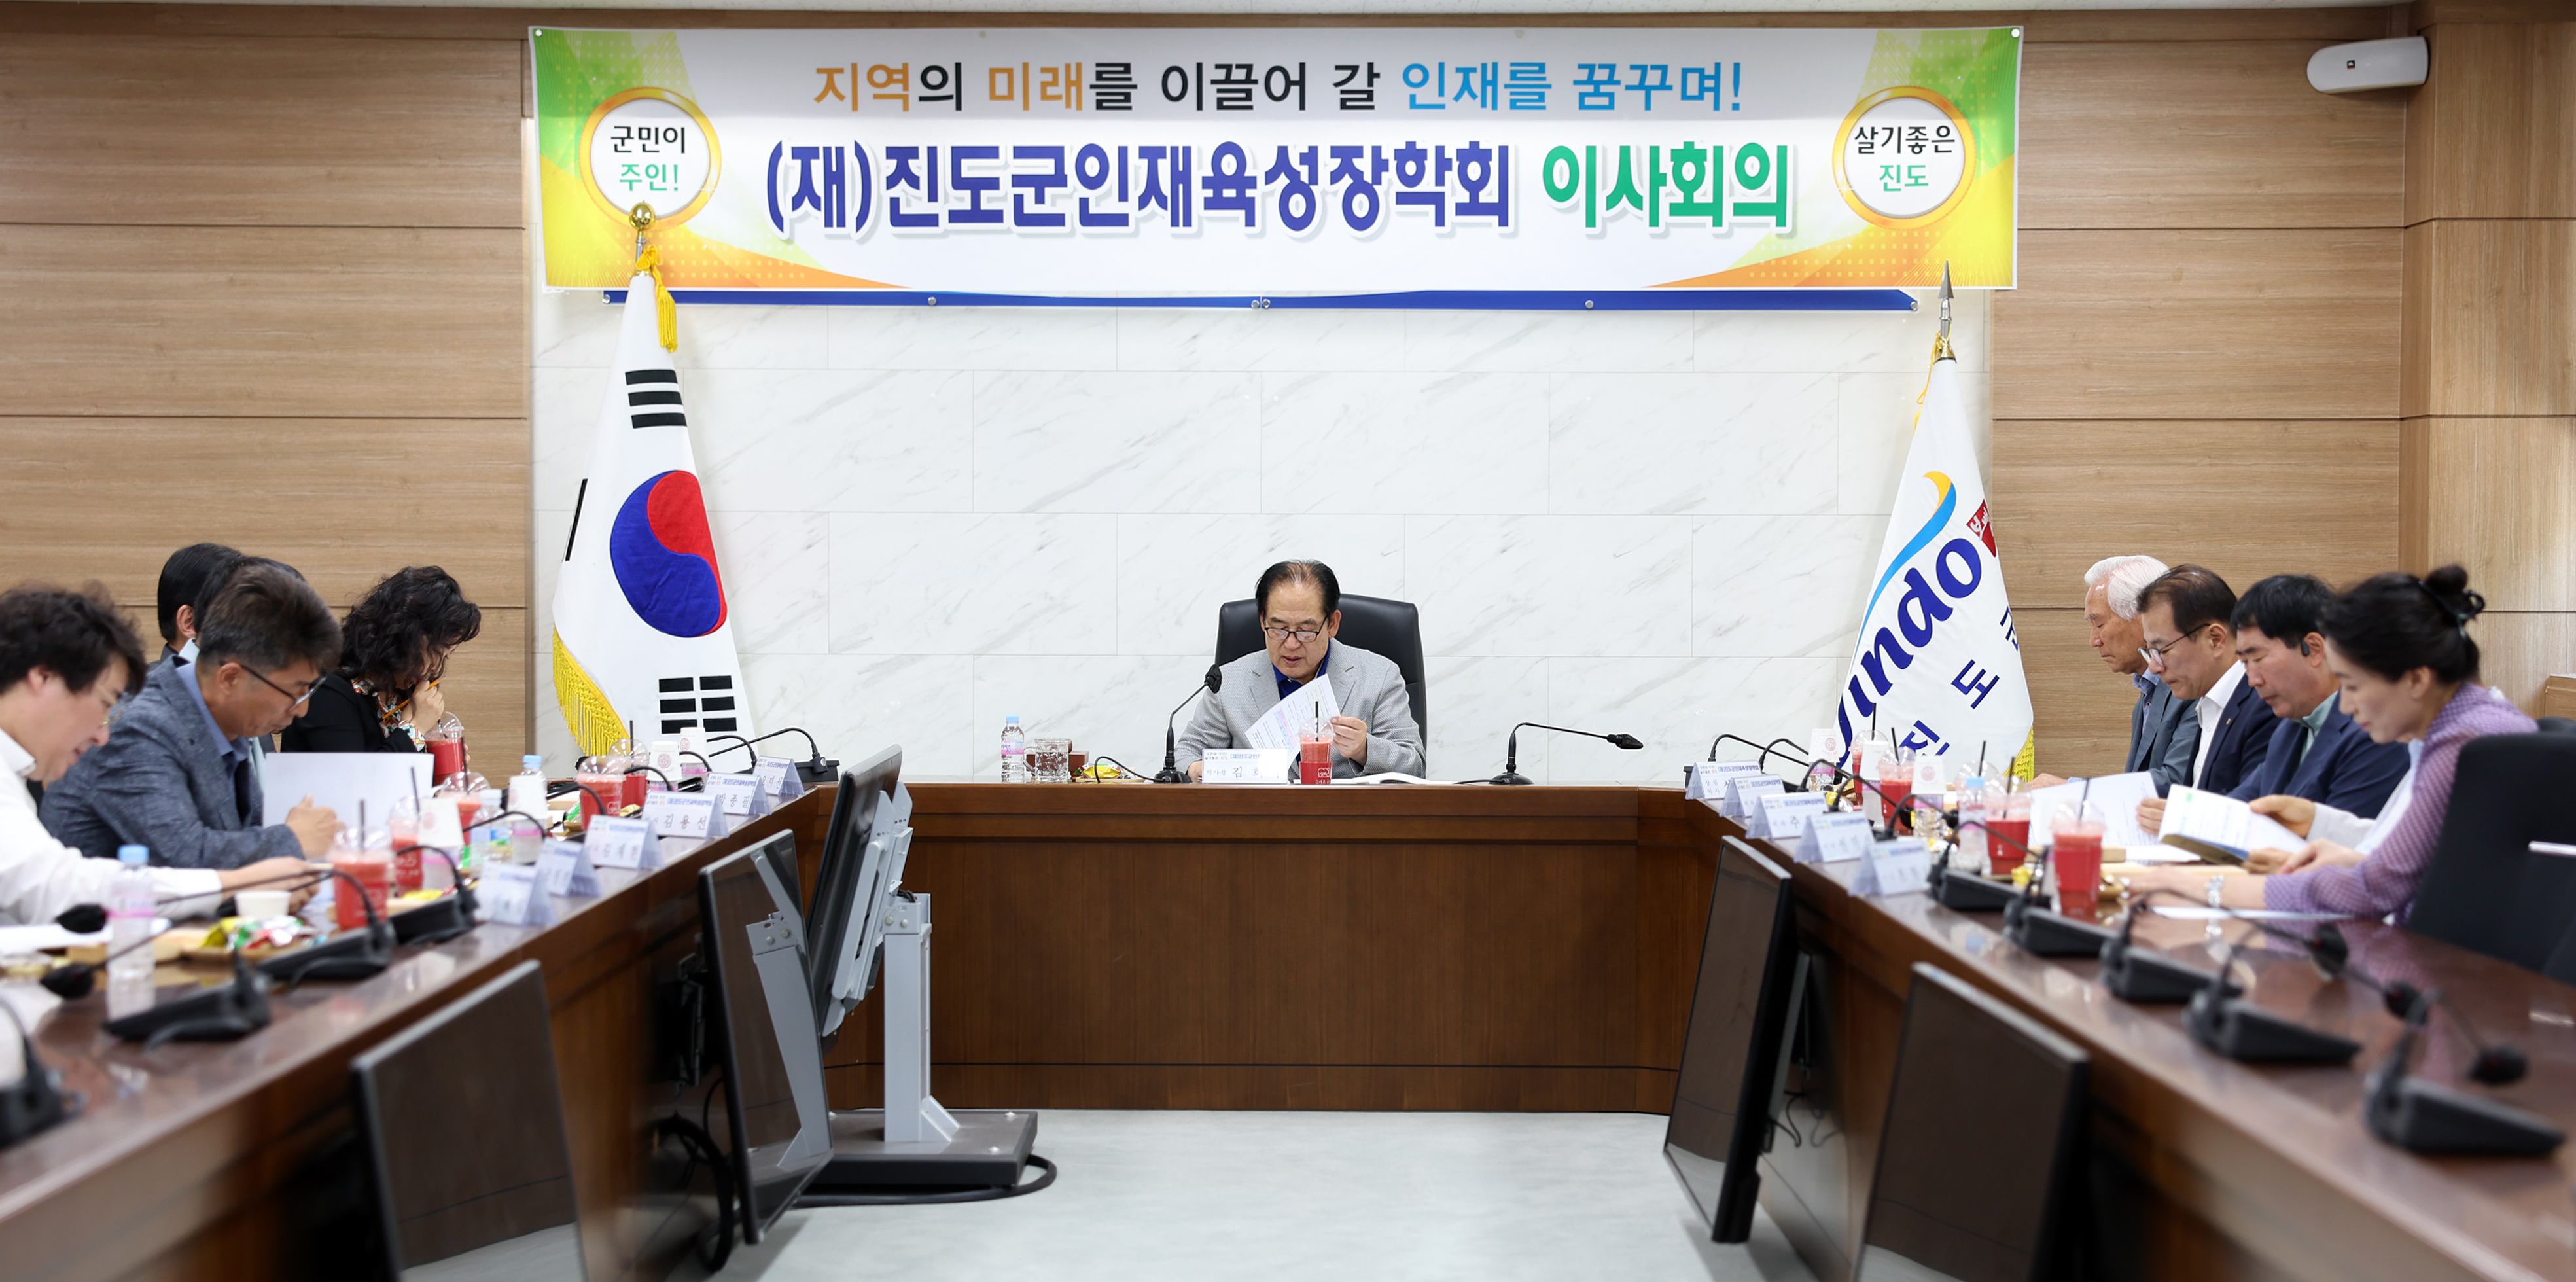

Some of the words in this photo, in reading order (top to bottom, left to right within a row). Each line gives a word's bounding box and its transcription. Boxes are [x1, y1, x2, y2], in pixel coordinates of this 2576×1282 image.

[815, 62, 962, 111] 지역의
[989, 62, 1138, 111] 미래를
[1161, 62, 1307, 111] 이끌어
[1333, 62, 1381, 111] 갈
[1403, 62, 1553, 111] 인재를
[1572, 62, 1741, 111] 꿈꾸며!
[611, 126, 686, 153] 군민이
[1854, 125, 1956, 154] 살기좋은
[619, 164, 679, 191] 주인!
[1543, 141, 1788, 228] 이사회의
[1879, 165, 1928, 192] 진도
[663, 813, 707, 831] 김용선
